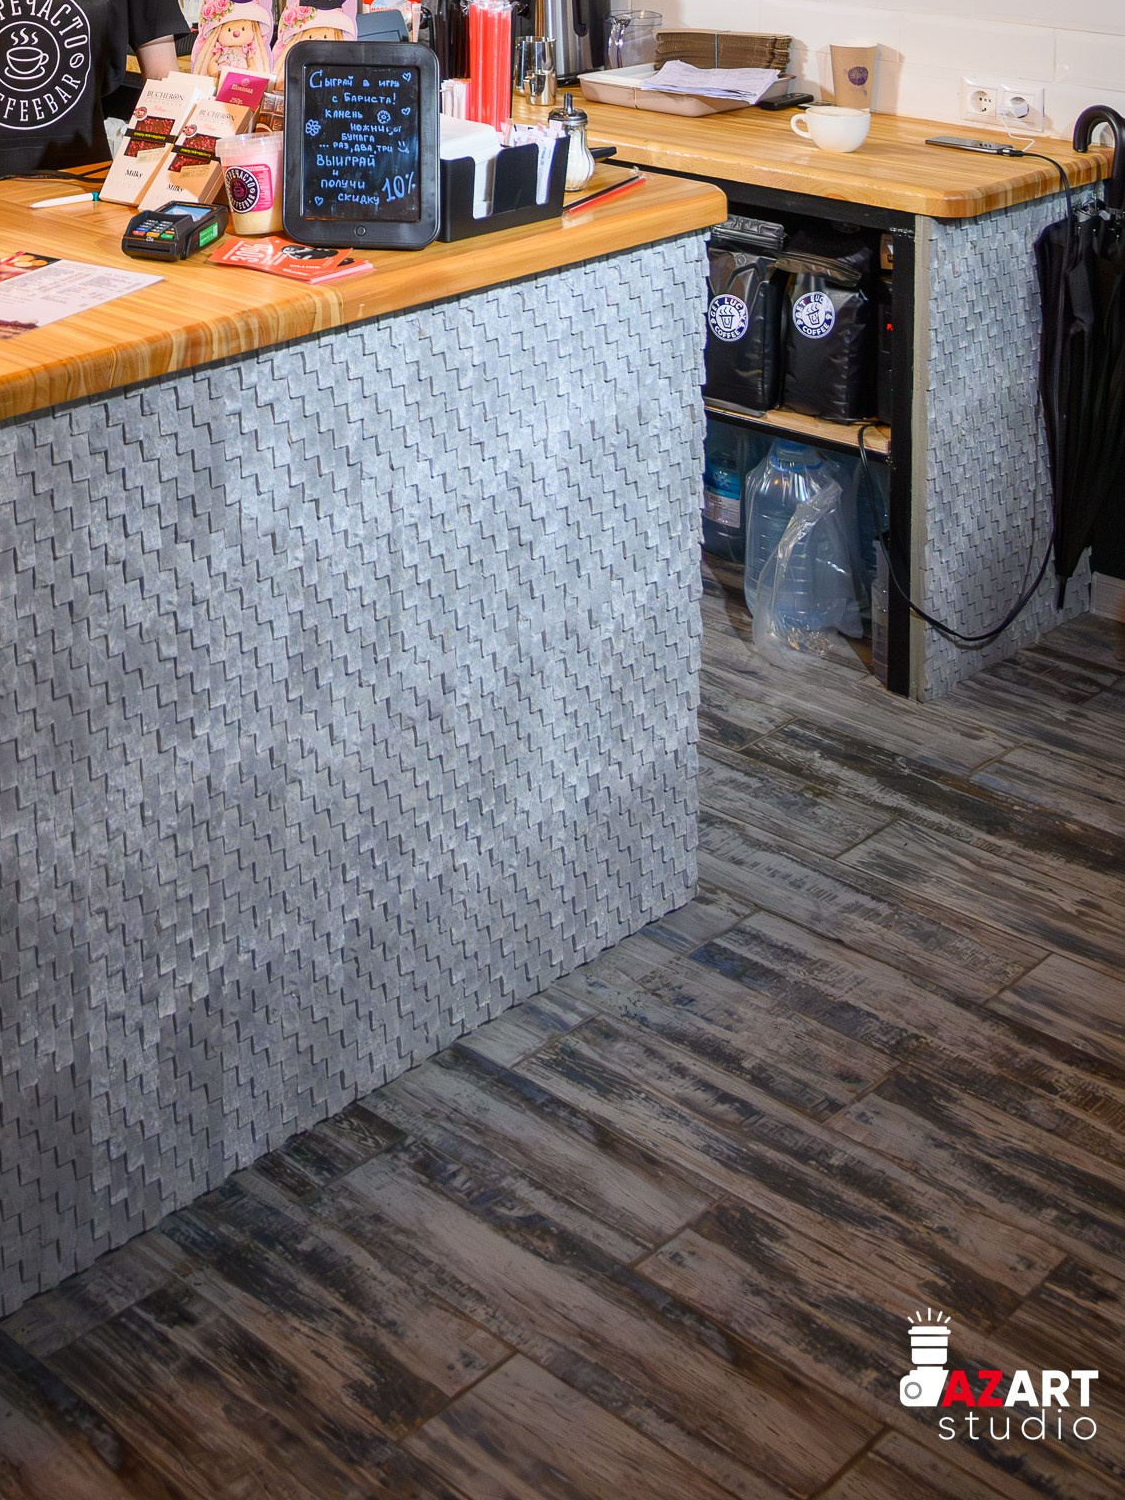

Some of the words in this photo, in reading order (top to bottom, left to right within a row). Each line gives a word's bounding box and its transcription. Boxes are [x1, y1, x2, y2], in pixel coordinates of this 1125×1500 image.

[125, 170, 143, 178] Milky
[382, 172, 416, 202] 10%
[715, 327, 740, 338] COFFEE
